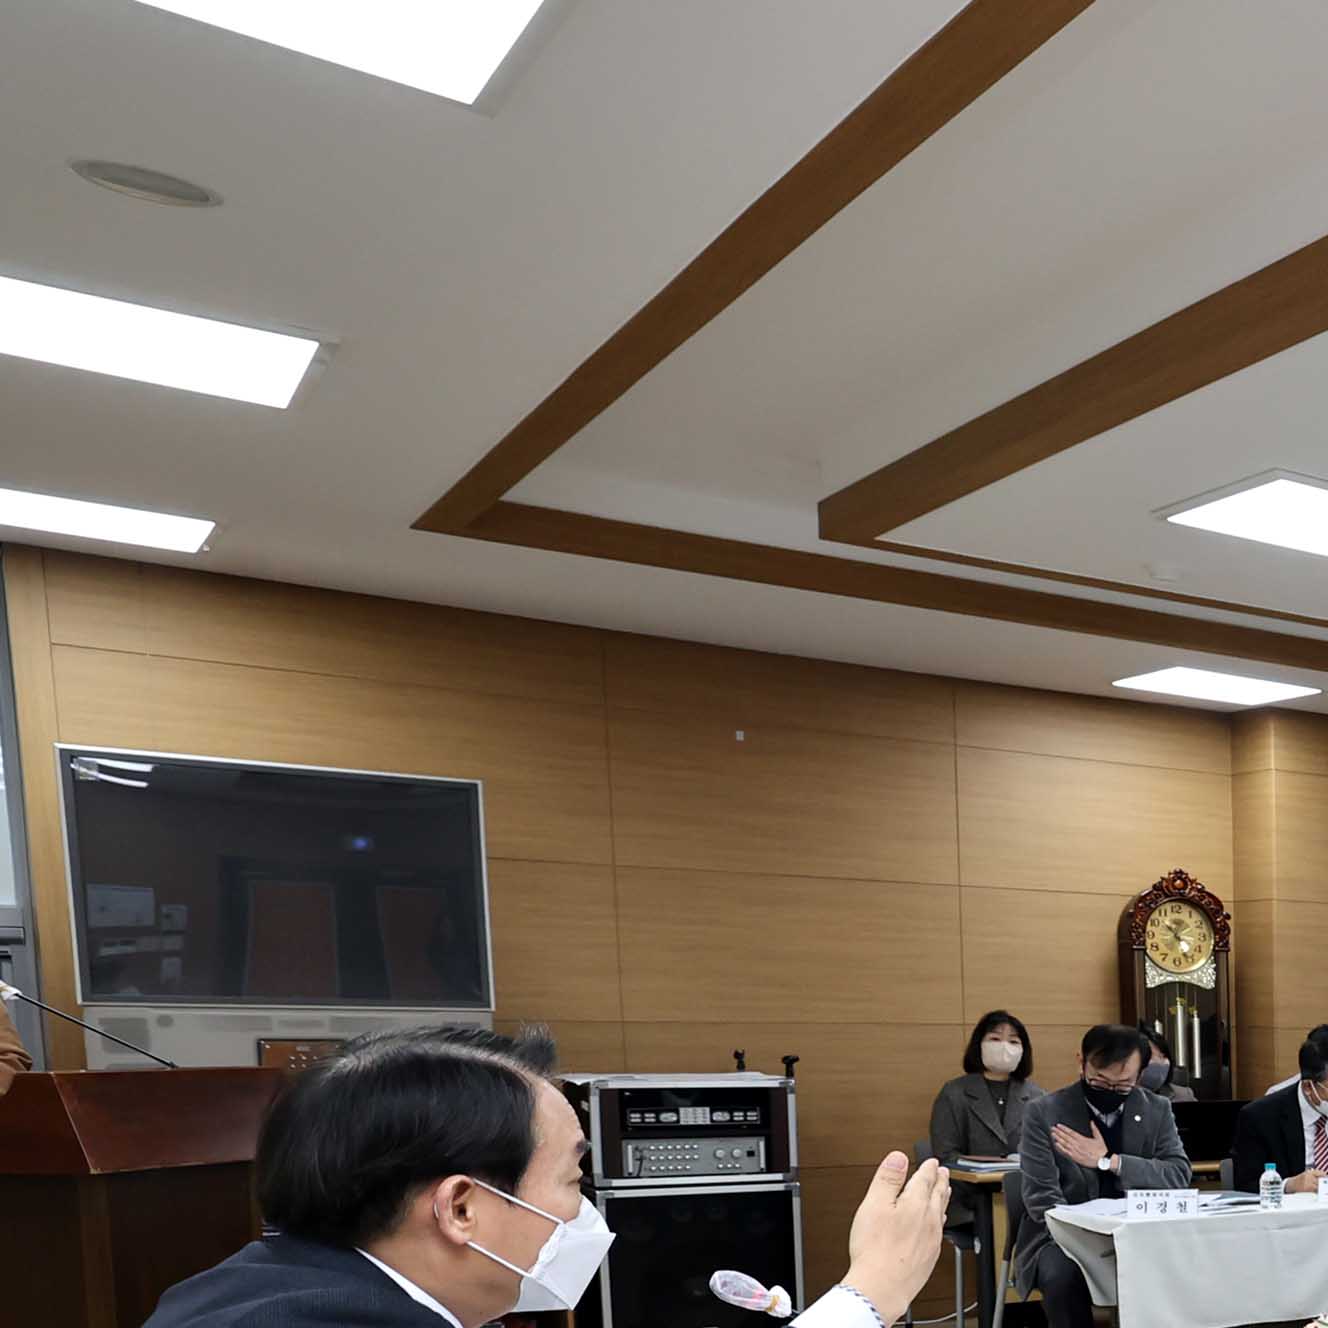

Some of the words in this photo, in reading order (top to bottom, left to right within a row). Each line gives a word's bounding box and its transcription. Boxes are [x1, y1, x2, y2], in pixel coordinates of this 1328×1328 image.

[1158, 908, 1168, 917] 11
[1171, 905, 1182, 914] 12
[1147, 930, 1155, 939] 9
[1150, 942, 1159, 951] 8
[1160, 953, 1168, 962] 7
[1173, 957, 1182, 967] 6
